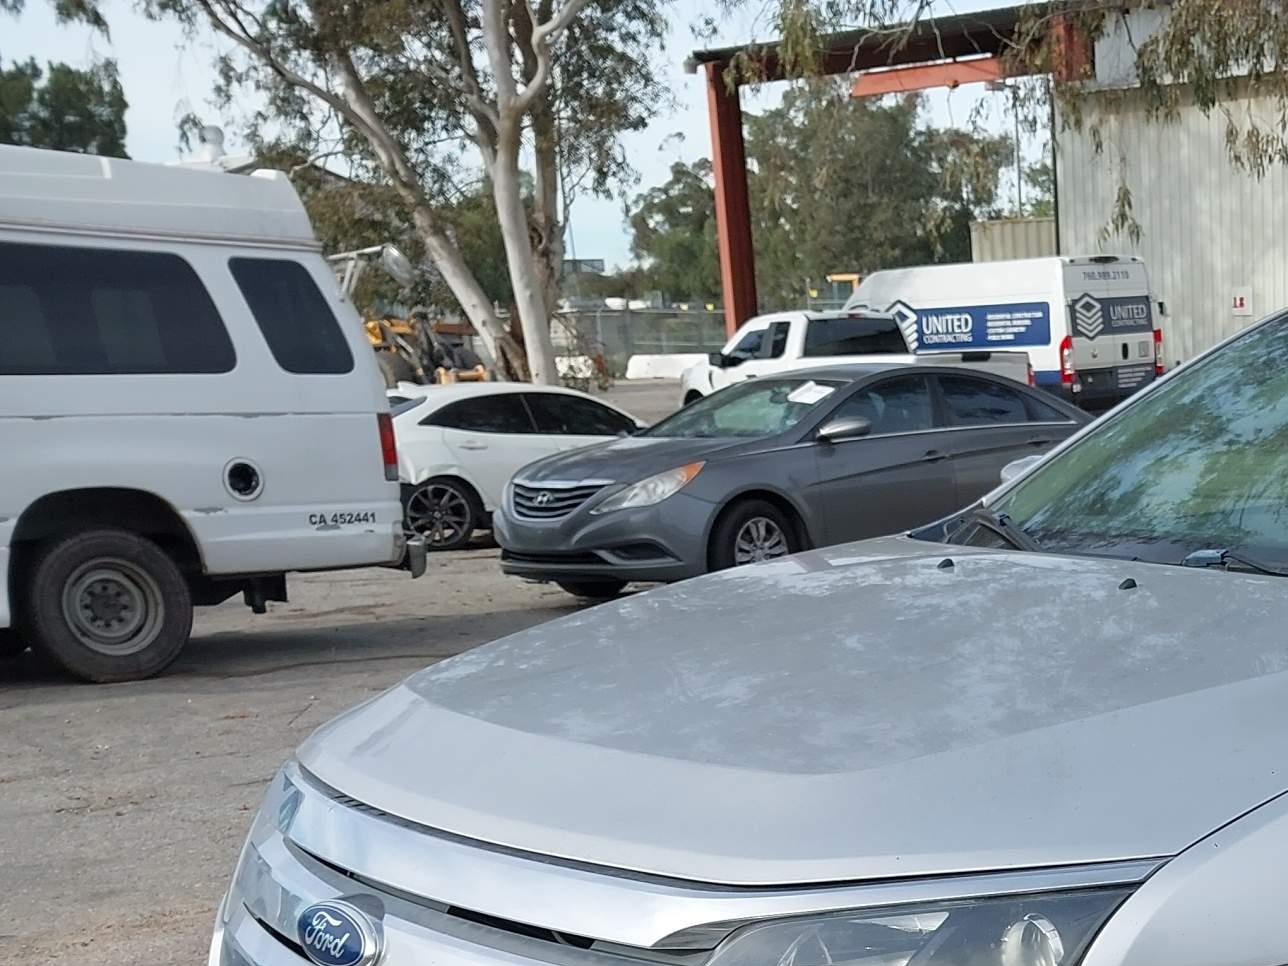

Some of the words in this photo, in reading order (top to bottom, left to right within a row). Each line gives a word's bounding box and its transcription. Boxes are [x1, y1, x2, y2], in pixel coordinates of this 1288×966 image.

[1110, 304, 1147, 320] UNITED
[922, 313, 973, 334] UNITED
[923, 333, 973, 344] CONTRACTING
[309, 514, 327, 525] CA
[331, 512, 376, 524] 452441
[304, 911, 351, 958] Ford
